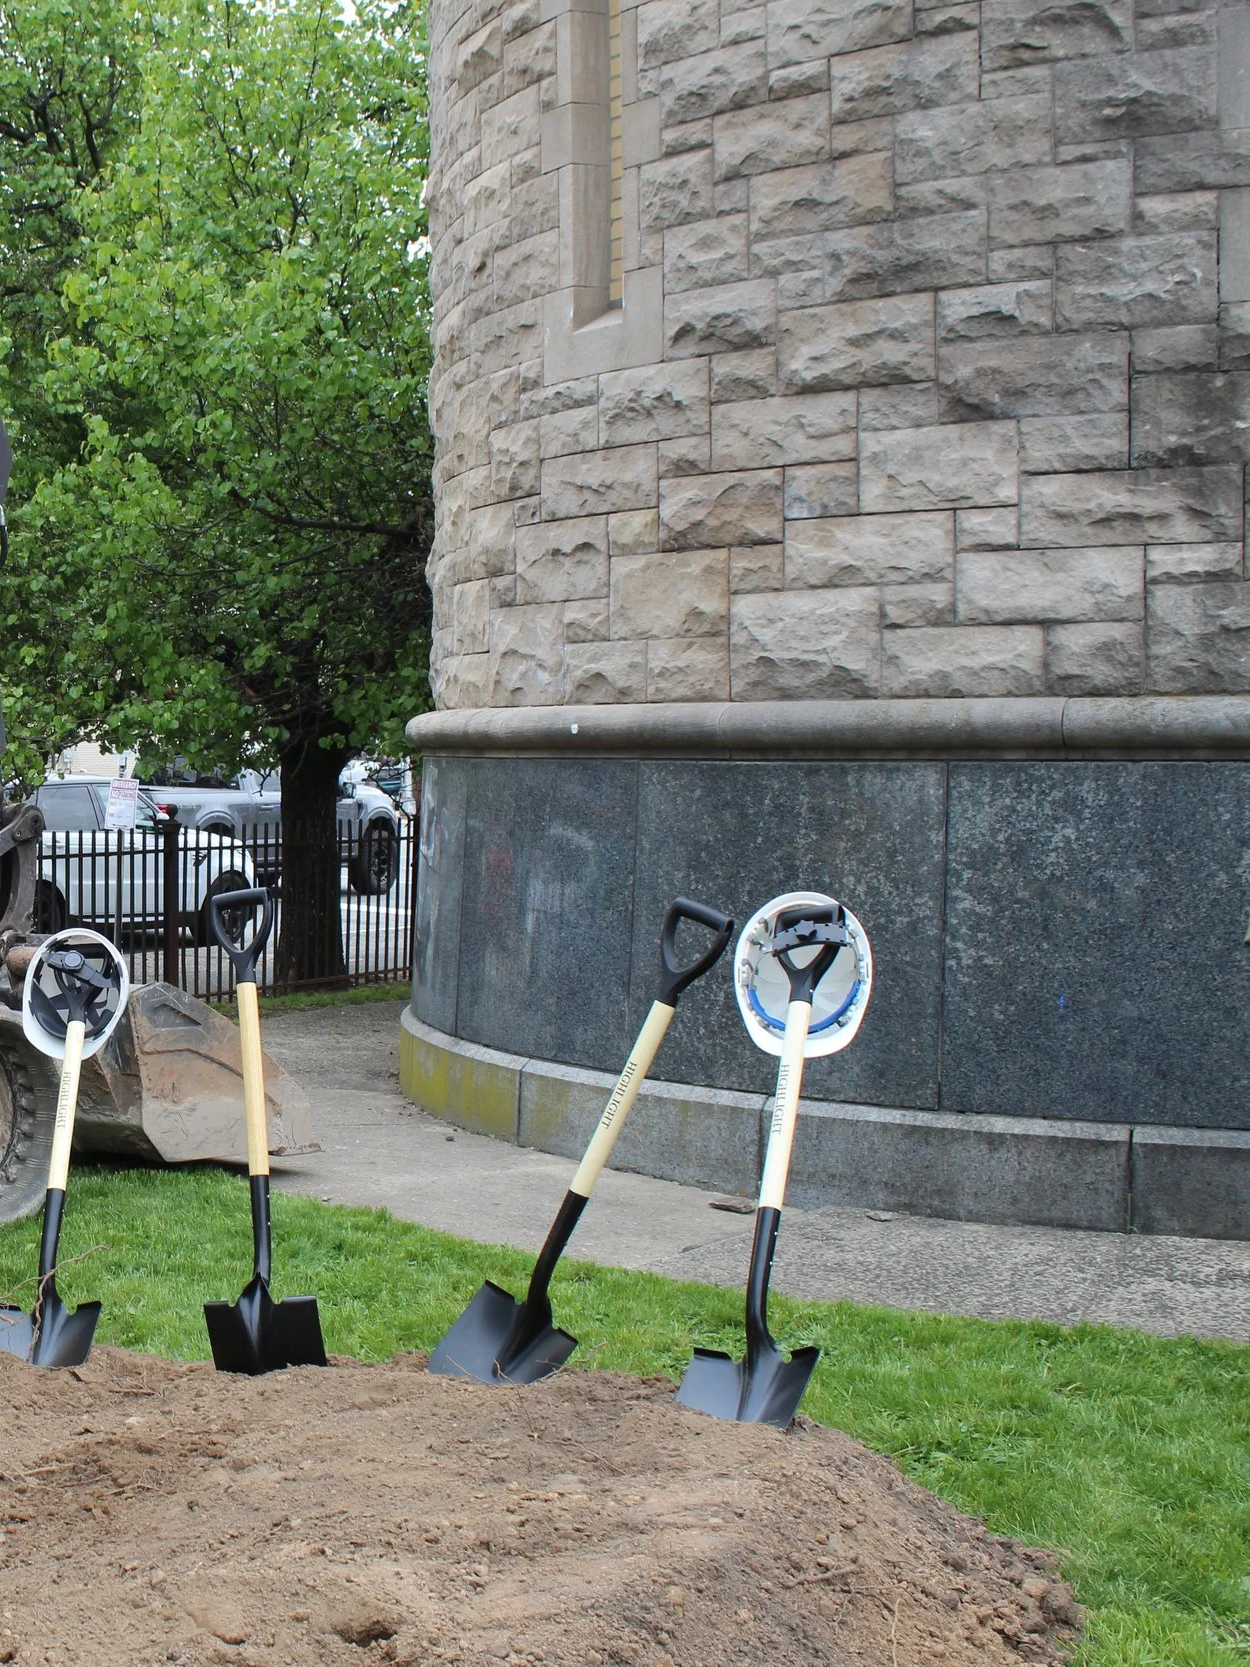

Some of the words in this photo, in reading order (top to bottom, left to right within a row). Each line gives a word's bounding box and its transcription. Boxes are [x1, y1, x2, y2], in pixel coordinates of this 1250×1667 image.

[56, 1071, 72, 1129] HIGHLIGHT
[600, 1060, 637, 1131] HIGHLIGHT
[771, 1064, 790, 1135] HIGHLIGHT
